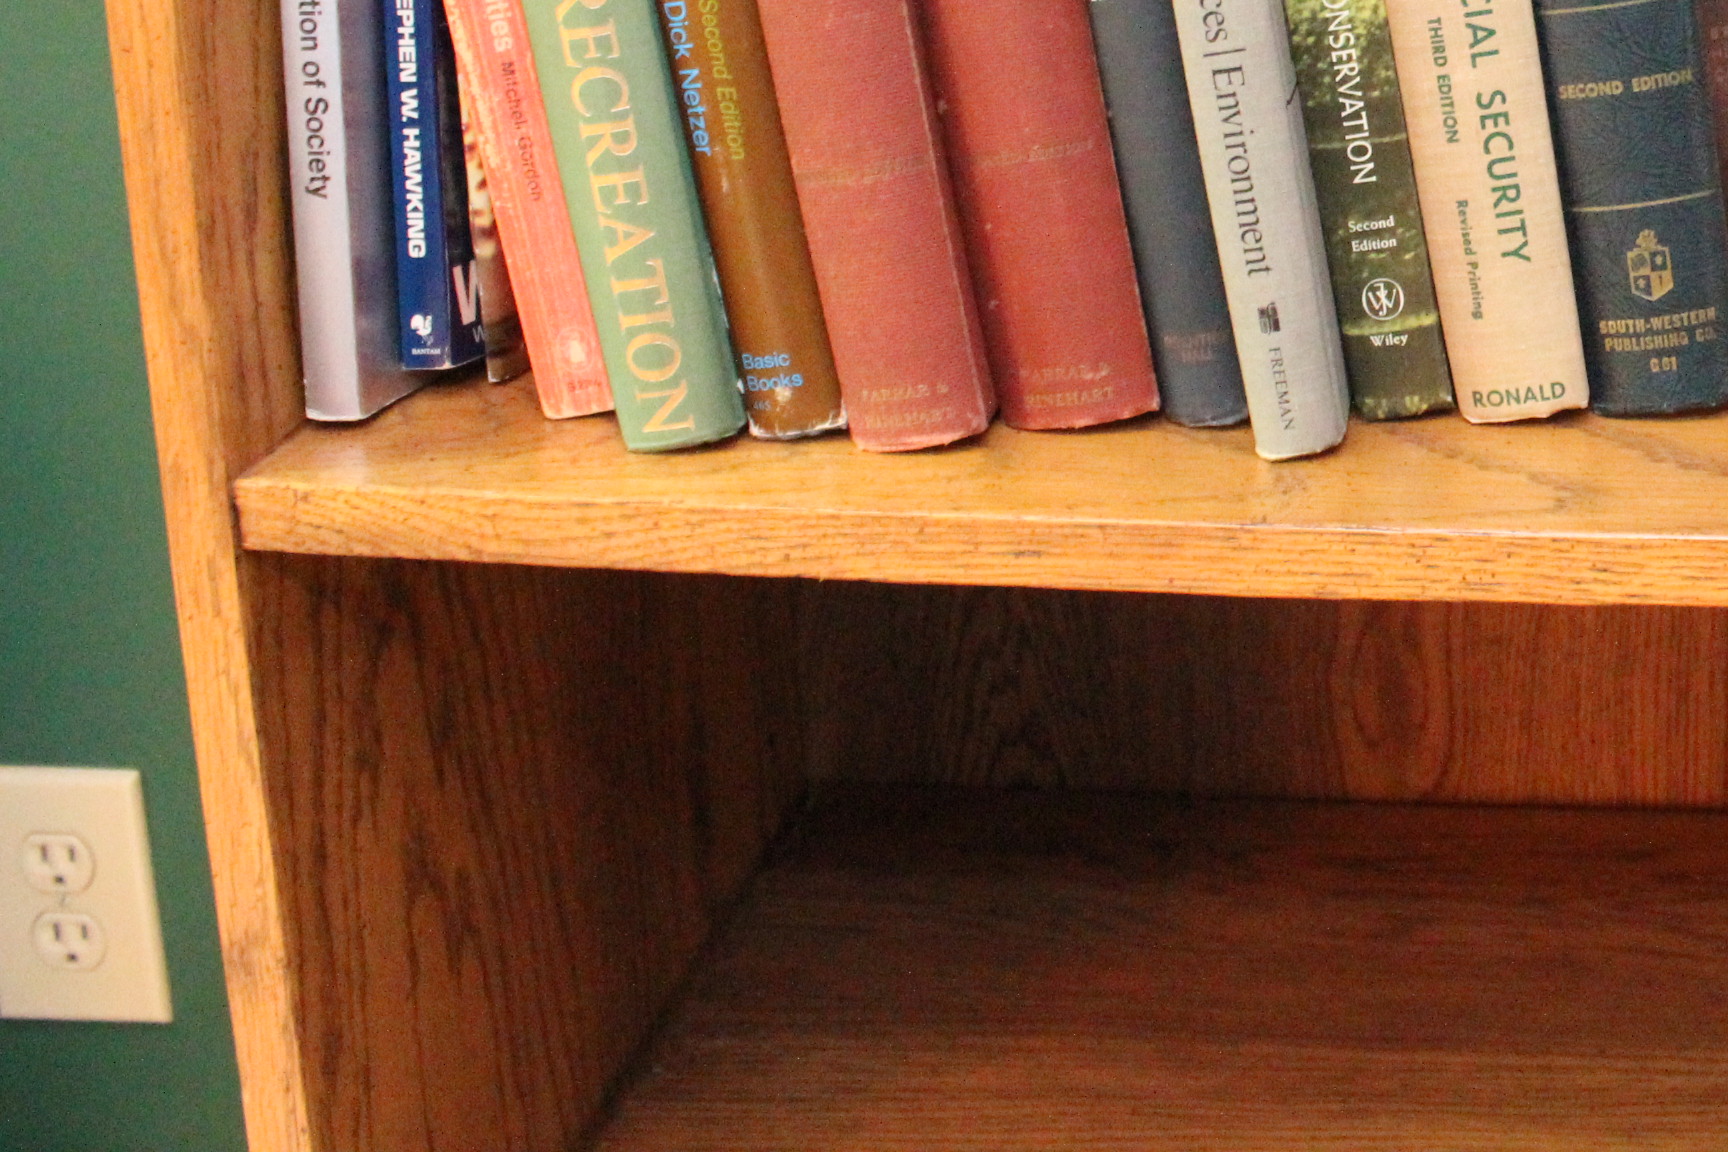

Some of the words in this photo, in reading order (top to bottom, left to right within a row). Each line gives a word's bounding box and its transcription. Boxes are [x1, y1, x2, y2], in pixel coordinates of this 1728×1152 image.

[1427, 17, 1449, 67] THIRD
[302, 61, 325, 88] of
[664, 0, 692, 58] Dick
[679, 67, 712, 157] Netzer
[1559, 79, 1623, 100] SECOND
[1632, 69, 1693, 94] EDITION
[400, 89, 418, 122] W.
[716, 87, 745, 161] Edition
[1435, 73, 1459, 144] EDITION
[304, 101, 330, 200] Society
[1212, 61, 1273, 278] Environment
[402, 127, 427, 259] HAWKING
[1476, 90, 1531, 263] SECURITY
[1347, 215, 1396, 233] Second
[1351, 235, 1398, 253] Edition
[1455, 199, 1475, 258] Revised
[1464, 262, 1484, 321] Printing
[1369, 331, 1410, 349] Wiley
[1599, 306, 1717, 334] SOUTH-WESTERN
[1604, 330, 1689, 351] PUBLISHING
[742, 352, 791, 370] Basic
[746, 373, 804, 392] Books
[1267, 347, 1296, 431] FREEMAN
[1472, 380, 1567, 408] RONALD
